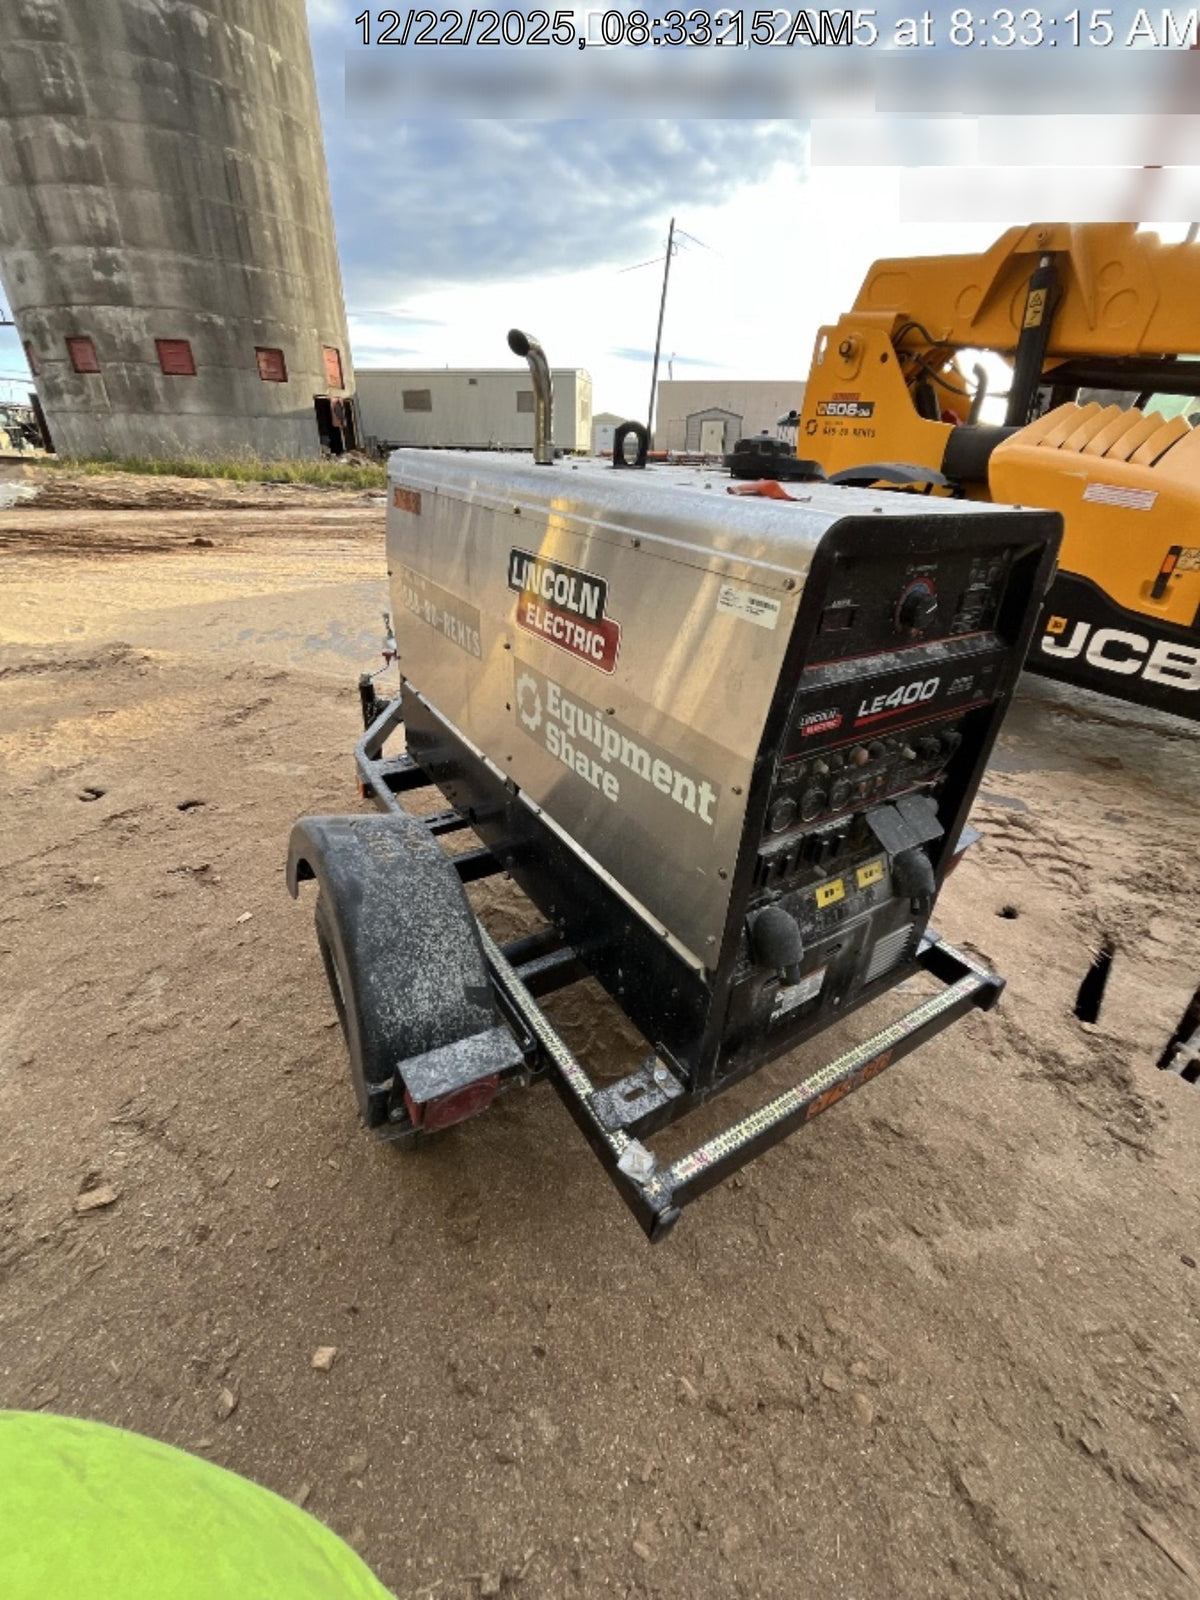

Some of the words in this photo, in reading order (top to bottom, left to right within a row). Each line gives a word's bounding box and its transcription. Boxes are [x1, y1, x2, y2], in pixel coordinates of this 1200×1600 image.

[511, 556, 601, 620] LINCOLN
[526, 602, 606, 660] ELECTRIC
[1041, 621, 1200, 690] JCB
[857, 676, 941, 718] LE400
[545, 721, 621, 803] Share
[546, 680, 718, 826] Equipment
[723, 1128, 743, 1146] NOT
[744, 1107, 776, 1132] STAND
